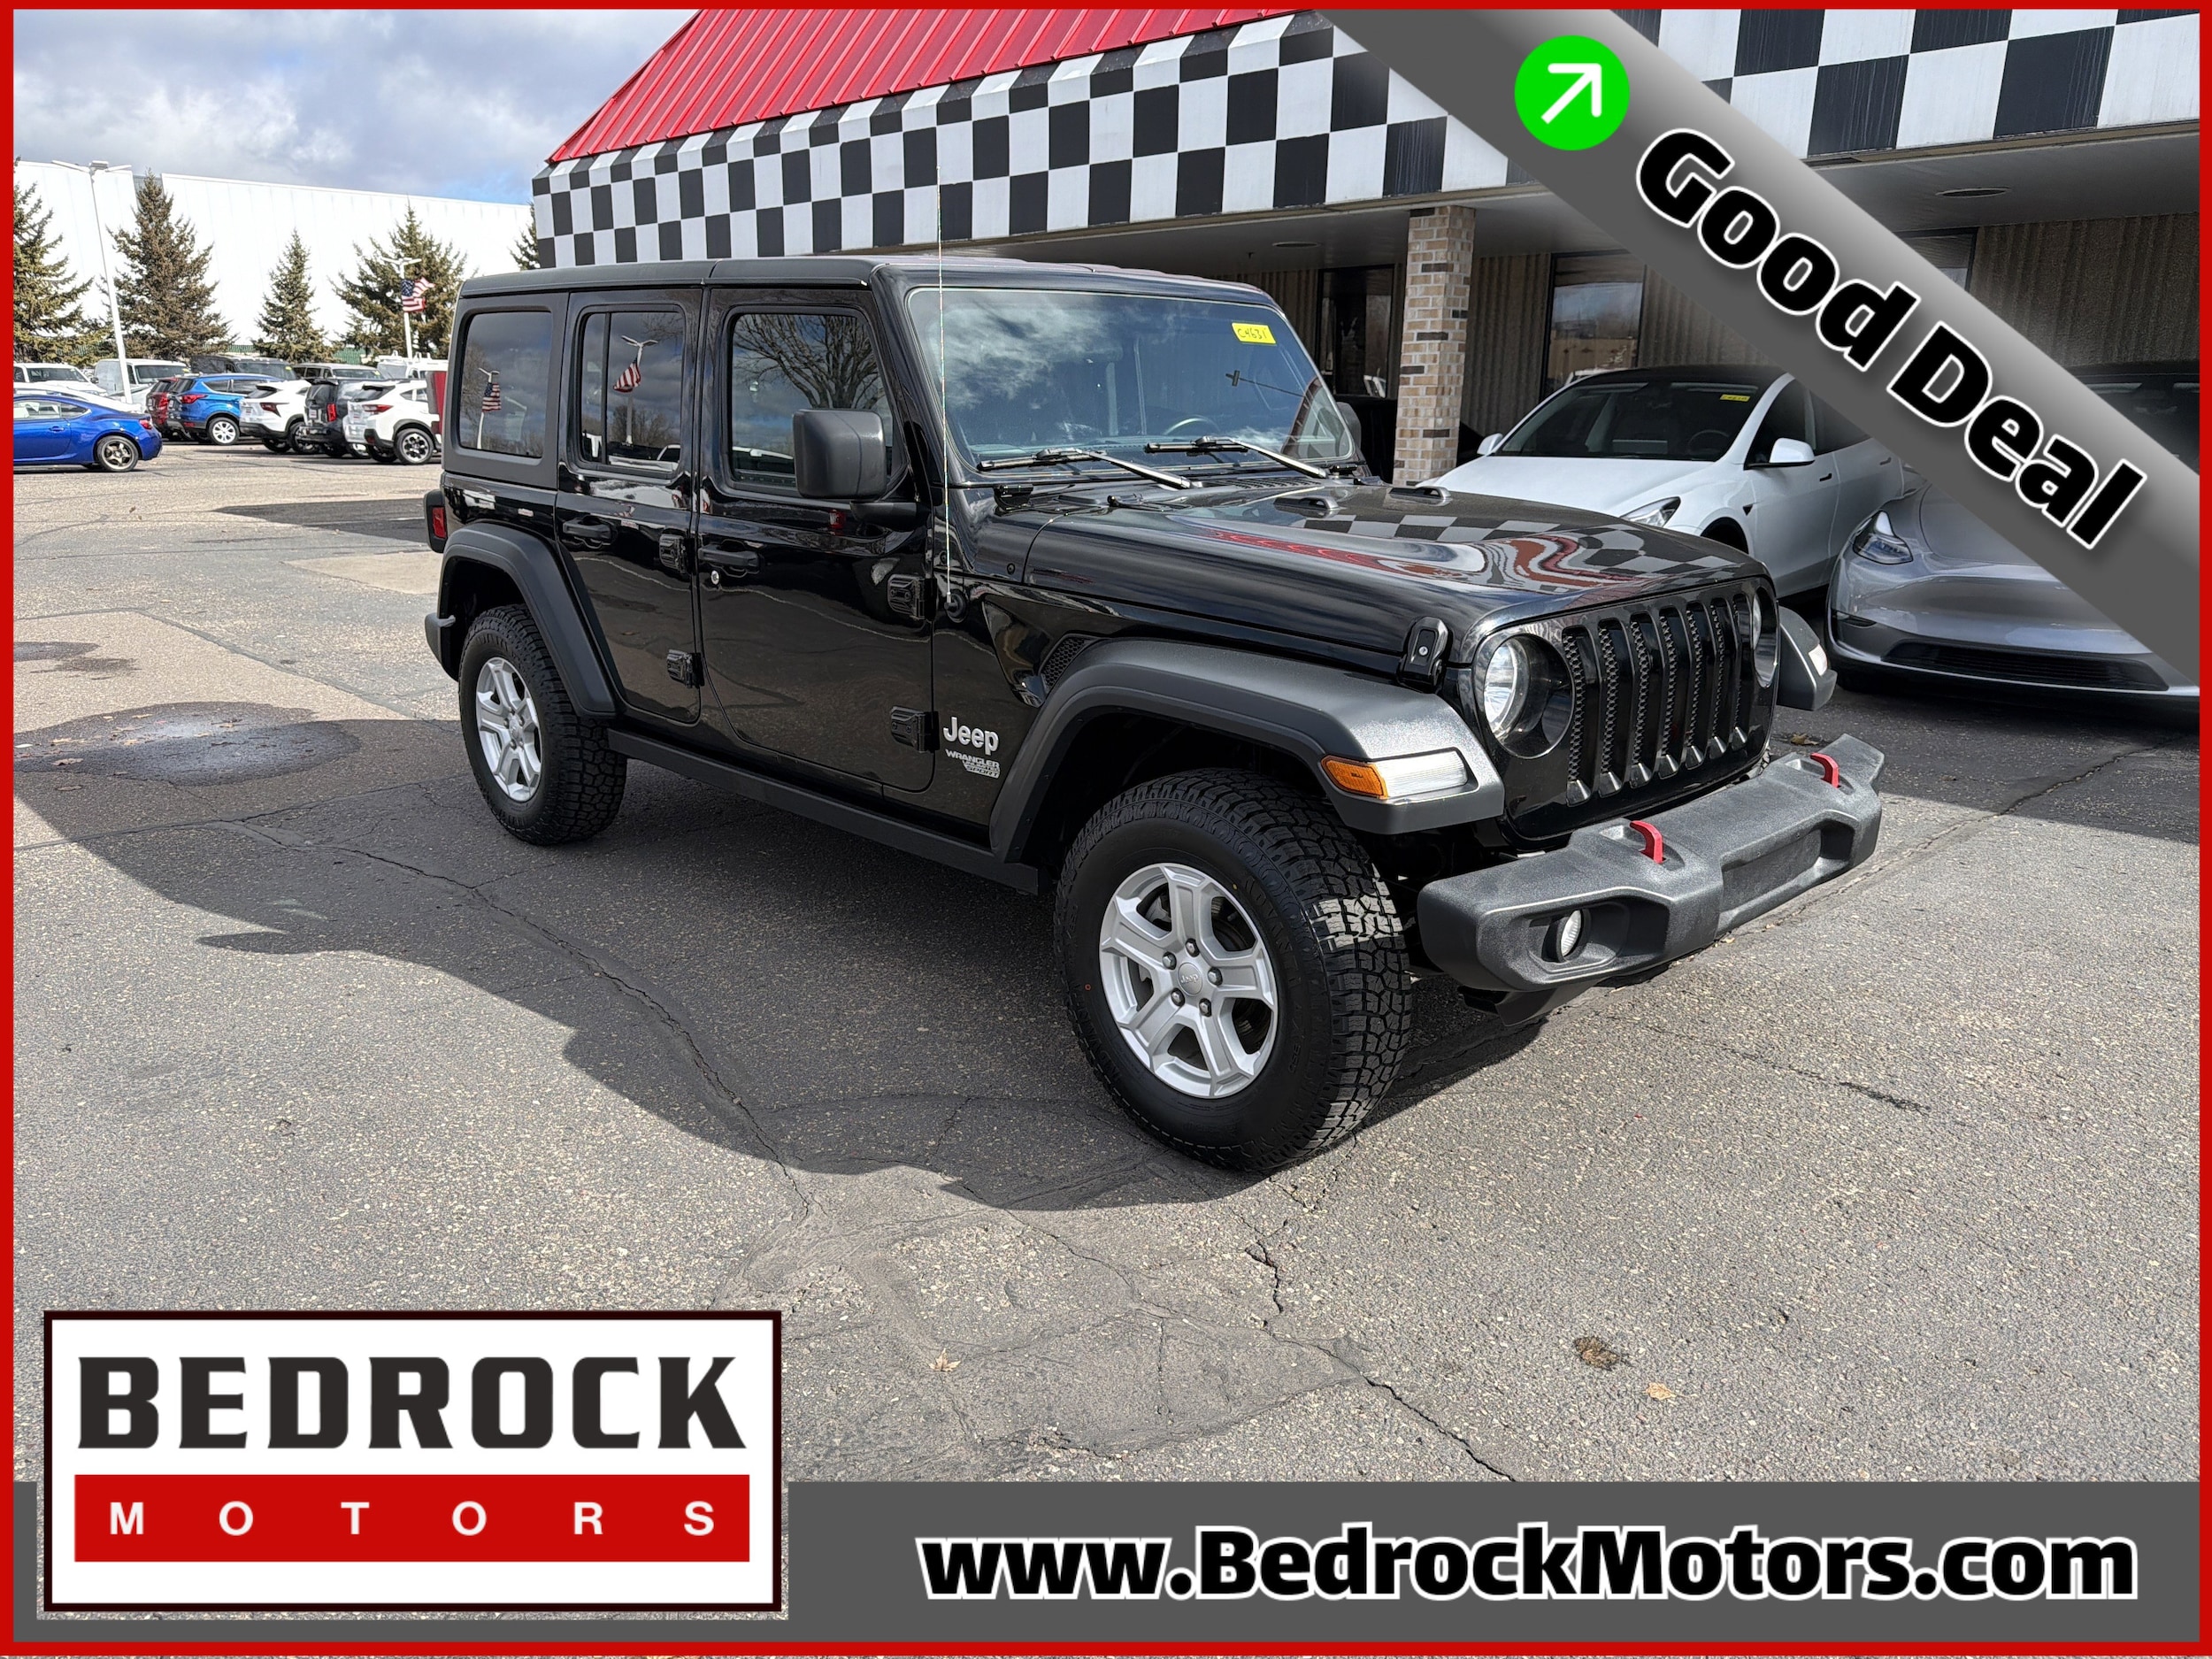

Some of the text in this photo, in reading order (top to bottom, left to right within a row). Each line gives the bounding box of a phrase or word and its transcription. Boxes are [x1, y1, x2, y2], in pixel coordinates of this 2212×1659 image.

[943, 716, 999, 756] Jeep
[945, 749, 1000, 768] WRANGLER
[1179, 972, 1200, 985] Jeep
